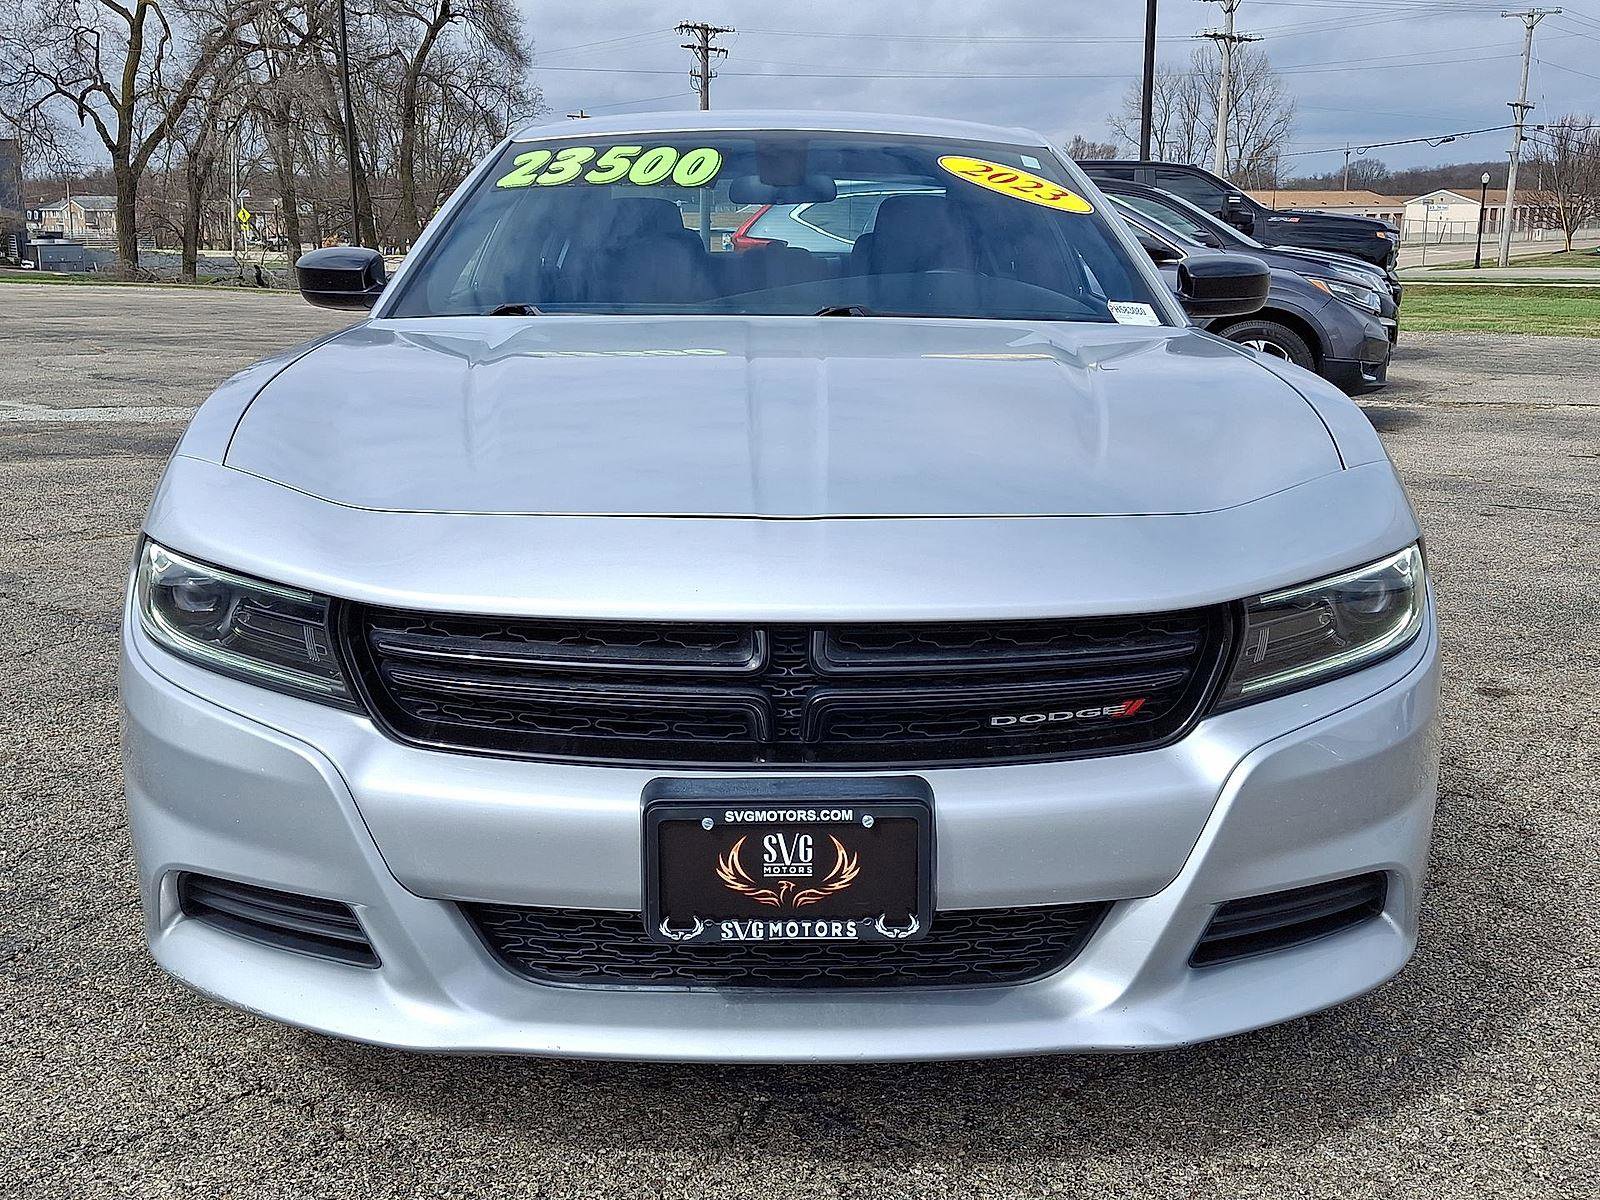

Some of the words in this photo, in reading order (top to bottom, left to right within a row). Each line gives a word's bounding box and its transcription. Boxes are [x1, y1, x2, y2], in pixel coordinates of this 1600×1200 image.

[496, 145, 723, 188] 23500
[958, 163, 1069, 201] 2023
[991, 704, 1127, 726] DODGE
[724, 809, 854, 823] SVGMOTORS.COM
[763, 833, 813, 866] SVG
[763, 866, 813, 874] MOTORS
[721, 919, 764, 940] SVG
[768, 919, 858, 938] MOTORS
